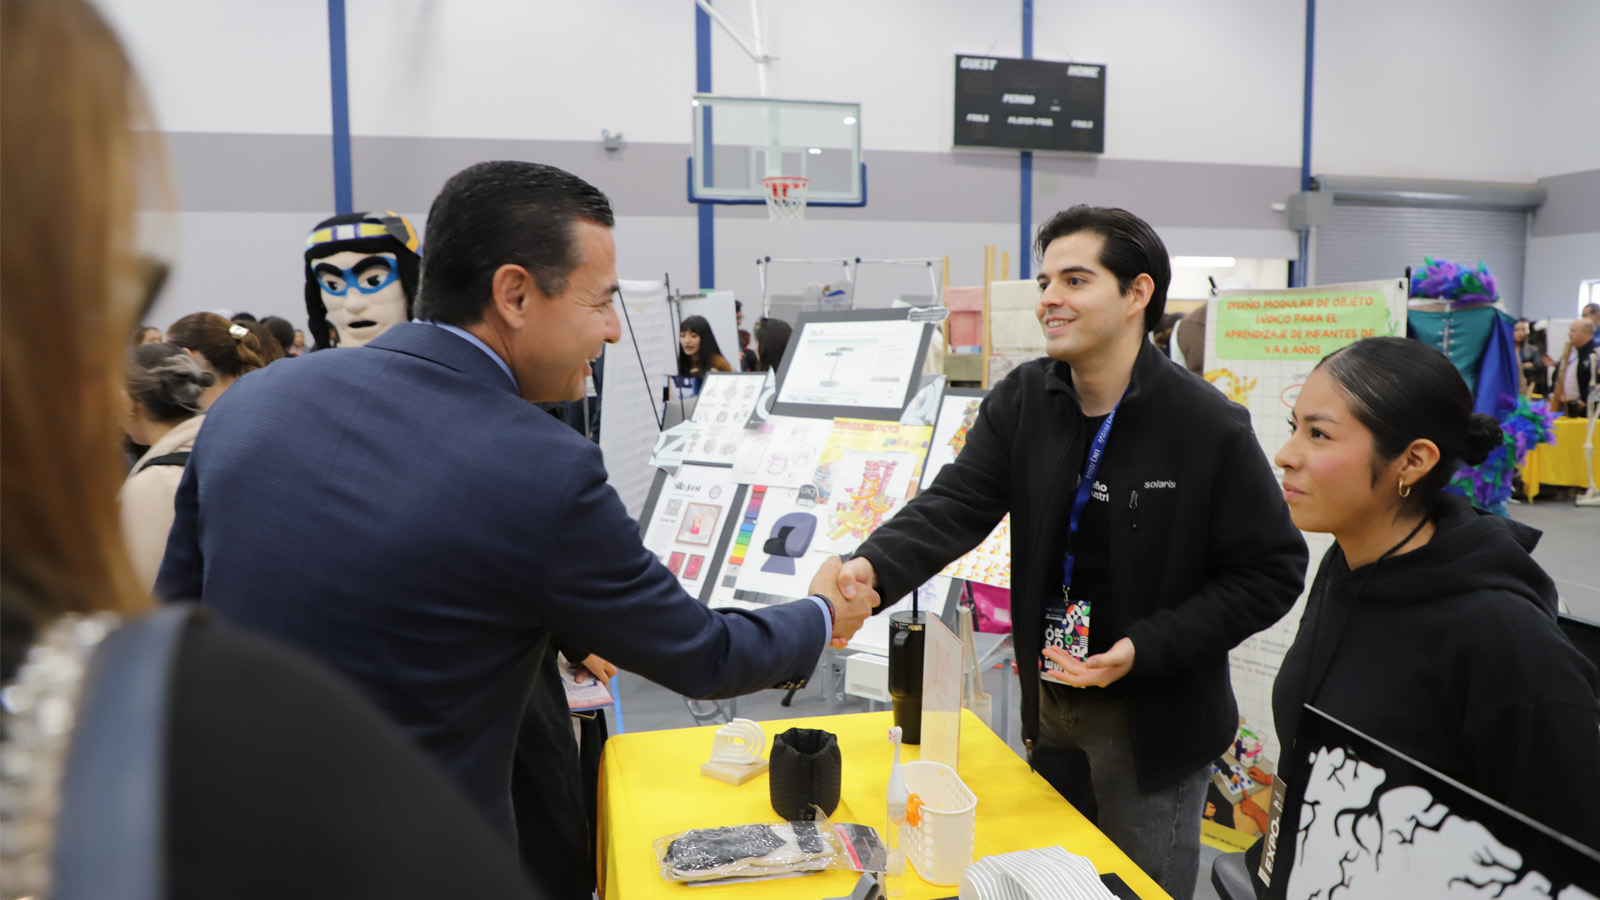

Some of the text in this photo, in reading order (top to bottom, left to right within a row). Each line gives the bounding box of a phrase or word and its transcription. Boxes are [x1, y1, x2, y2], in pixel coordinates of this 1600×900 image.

[960, 57, 998, 71] GUEST
[1002, 93, 1036, 105] PERIOD
[1227, 296, 1374, 310] DISEÑO MODULAR DE OBJETO
[1256, 313, 1338, 325] LÚDICO PARA EL
[1224, 328, 1376, 340] APRENDIZAJE DE INFANTES DE
[1265, 342, 1322, 354] 4 A 6 AÑOS
[1143, 479, 1177, 489] solaris
[1044, 624, 1055, 669] EPO-
[1265, 816, 1280, 874] EXPO-
